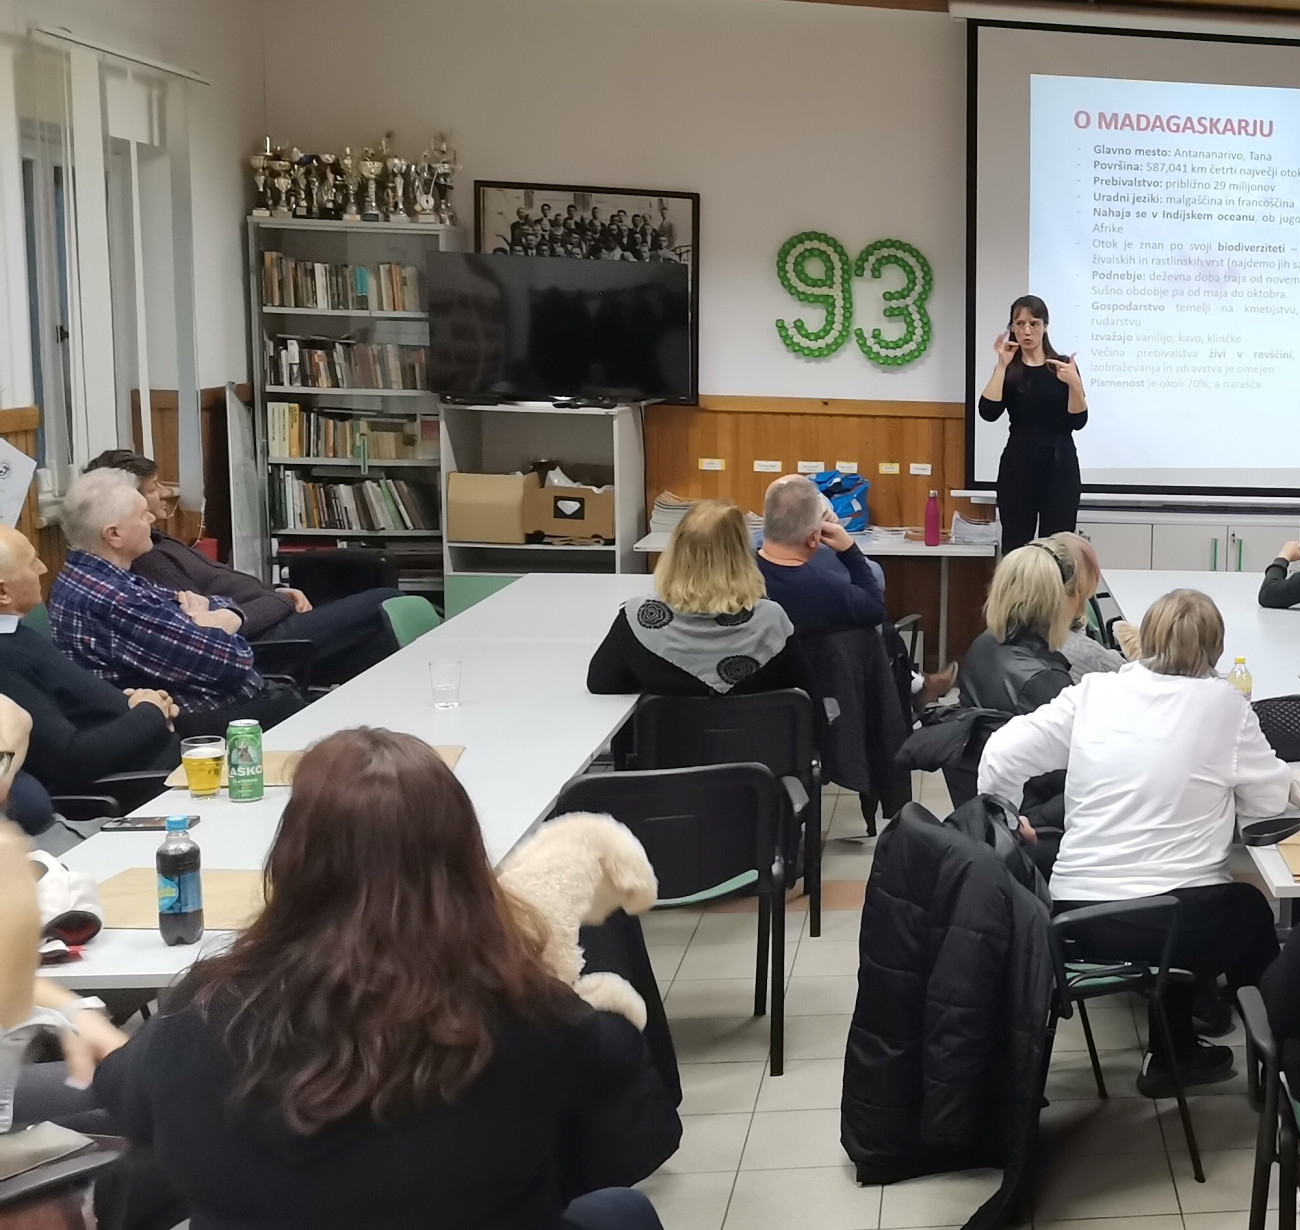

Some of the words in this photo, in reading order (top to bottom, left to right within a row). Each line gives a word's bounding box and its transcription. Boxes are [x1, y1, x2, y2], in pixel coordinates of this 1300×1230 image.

[1074, 110, 1090, 129] O
[1098, 112, 1274, 138] MADAGASKARJU
[1093, 144, 1132, 156] Glavno
[1134, 147, 1171, 158] mesto:
[1174, 148, 1246, 162] Antananarivo,
[1248, 151, 1272, 162] Tana
[1093, 160, 1143, 172] Površina:
[1146, 162, 1188, 174] 587,041
[1190, 164, 1207, 174] km
[1209, 164, 1238, 175] četrti
[1093, 176, 1163, 188] Prebivalstvo:
[1165, 178, 1210, 192] približno
[1212, 181, 1226, 190] 29
[1228, 181, 1276, 194] milijonov
[1093, 192, 1130, 202] Uradni
[1130, 193, 1163, 206] jeziki:
[1166, 194, 1222, 208] malgaščina
[1224, 196, 1235, 206] in
[1093, 208, 1131, 220] Nahaja
[1135, 211, 1147, 219] se
[1162, 209, 1212, 224] Indijskem
[1217, 213, 1258, 224] oceanu,
[1262, 212, 1275, 223] ob
[1093, 224, 1124, 234] Afrike
[1092, 238, 1118, 249] Otok
[1122, 240, 1134, 252] je
[1139, 242, 1164, 250] znan
[1170, 242, 1184, 254] po
[1189, 242, 1212, 254] svoji
[1218, 242, 1286, 254] biodiverziteti
[1092, 254, 1136, 266] živalskih
[1138, 256, 1148, 265] in
[1151, 256, 1203, 267] rastlinskih
[1205, 258, 1224, 268] vrst
[1226, 258, 1276, 270] (najdemo
[1276, 260, 1290, 270] jih
[1194, 272, 1220, 282] doba
[1224, 274, 1247, 285] traja
[1250, 274, 1264, 284] od
[776, 231, 932, 366] 93
[1092, 286, 1123, 296] Sušno
[1126, 286, 1169, 299] obdobje
[1172, 290, 1184, 300] pa
[1187, 288, 1201, 298] od
[1203, 289, 1228, 301] maja
[1230, 288, 1244, 298] do
[1246, 289, 1288, 300] oktobra.
[1091, 301, 1166, 314] Gospodarstvo
[1176, 303, 1211, 316] temelji
[1221, 306, 1234, 314] na
[1092, 316, 1142, 327] rudarstvu
[1091, 332, 1133, 344] Izvažajo
[1136, 332, 1176, 346] vanilijo,
[1178, 334, 1205, 344] kavo,
[1207, 333, 1242, 344] klinčke
[1090, 347, 1125, 358] Večina
[1136, 348, 1198, 361] prebivalstva
[1209, 349, 1226, 358] živi
[1162, 364, 1172, 373] in
[1175, 364, 1222, 374] zdravstva
[1224, 364, 1234, 376] je
[1236, 366, 1275, 376] omejen
[1090, 378, 1144, 388] Pismenost
[1147, 379, 1157, 391] je
[1160, 379, 1184, 389] okoli
[1222, 380, 1261, 390] narašča
